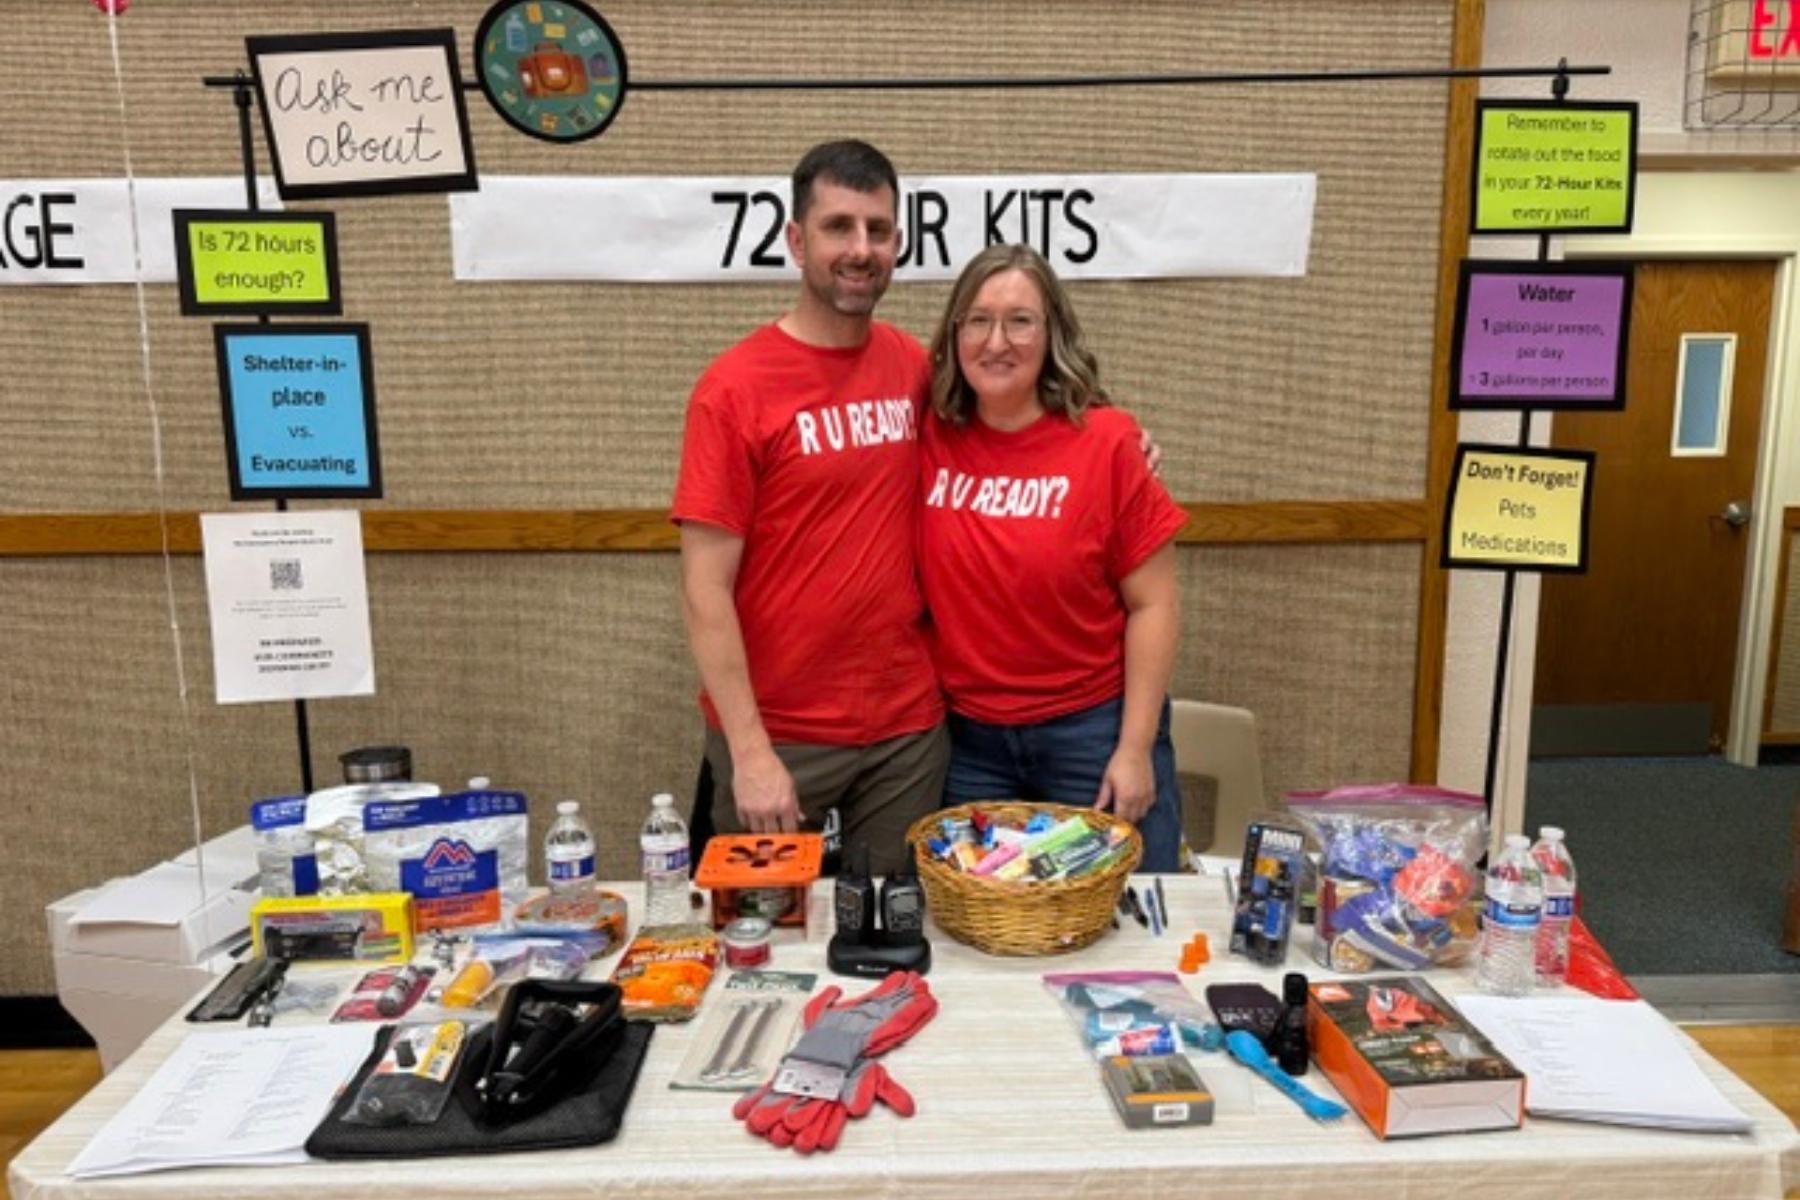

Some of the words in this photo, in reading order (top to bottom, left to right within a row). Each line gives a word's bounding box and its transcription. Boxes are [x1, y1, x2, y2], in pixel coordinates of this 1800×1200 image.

[370, 74, 443, 102] me
[1507, 113, 1587, 131] Remember
[1592, 118, 1607, 132] to
[306, 115, 442, 167] about
[1487, 146, 1531, 161] rotate
[1535, 148, 1556, 162] out
[1560, 148, 1584, 162] the
[1588, 148, 1621, 162] food
[1484, 174, 1497, 187] in
[1499, 176, 1530, 192] your
[1535, 175, 1592, 190] 72-Hour
[1595, 176, 1623, 190] Kits
[1512, 206, 1551, 223] every
[1554, 205, 1590, 223] year!
[0, 193, 84, 269] GE
[711, 191, 786, 268] 72
[985, 189, 1099, 264] KITS
[199, 230, 217, 251] Is
[222, 230, 251, 251] 72
[255, 231, 316, 254] hours
[214, 269, 305, 294] enough?
[1518, 284, 1576, 303] Water
[1481, 317, 1489, 333] 1
[1532, 321, 1554, 336] per
[243, 354, 347, 372] Shelter-in-
[1516, 347, 1537, 360] per
[1540, 346, 1565, 360] day
[1479, 371, 1489, 386] 3
[271, 386, 327, 408] place
[286, 425, 314, 438] vs.
[796, 411, 822, 455] R
[821, 405, 845, 451] U
[251, 454, 357, 475] Evacuating
[1466, 460, 1515, 483] Don't
[1517, 464, 1579, 491] Forget!
[926, 467, 949, 506] R
[952, 472, 974, 509] U
[970, 475, 1070, 518] READY?
[1498, 498, 1537, 519] Pets
[1461, 531, 1568, 557] Medications
